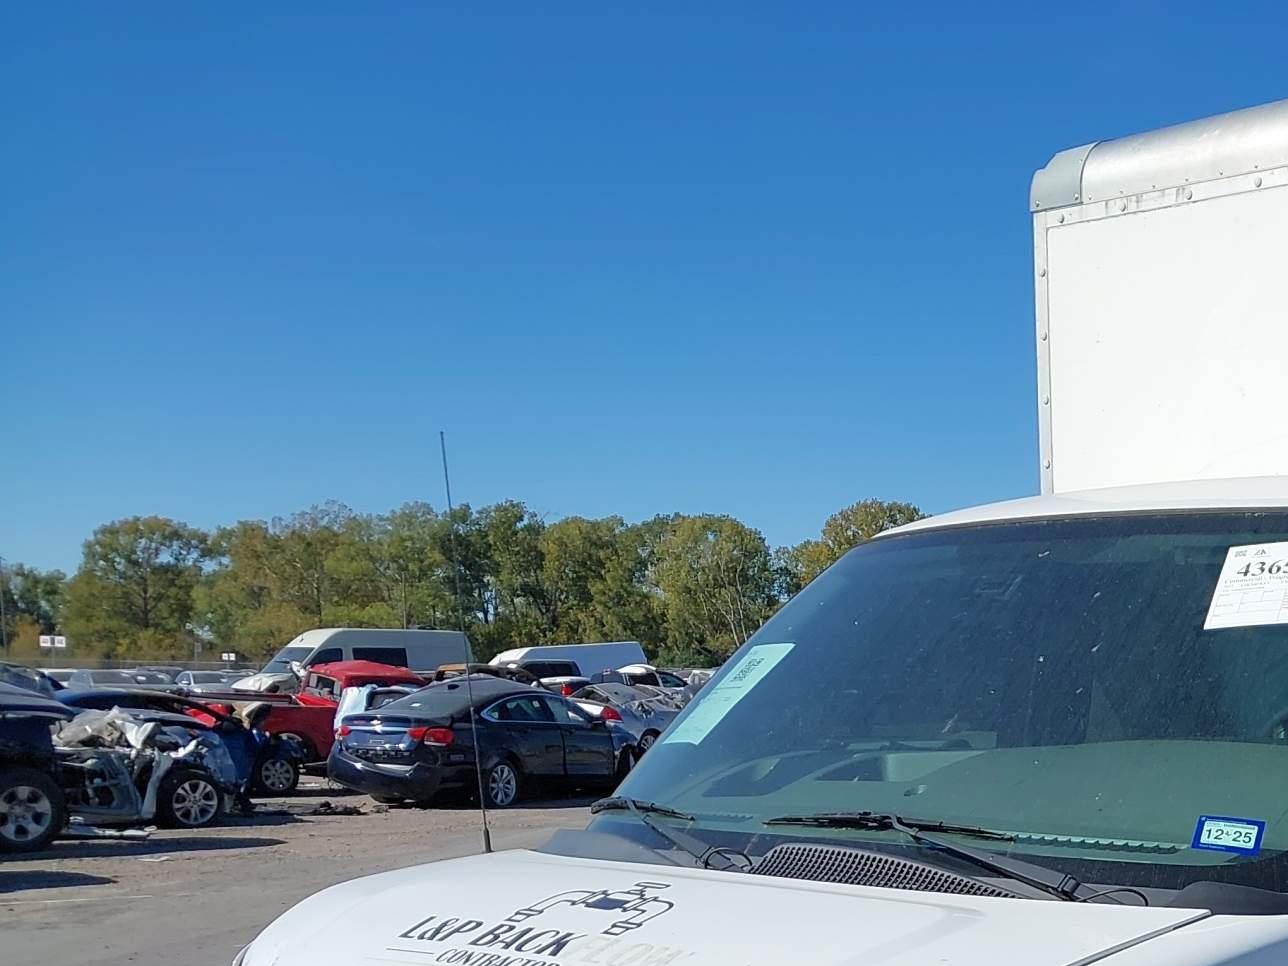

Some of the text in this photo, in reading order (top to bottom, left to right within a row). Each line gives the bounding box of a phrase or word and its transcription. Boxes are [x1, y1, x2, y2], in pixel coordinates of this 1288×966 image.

[1205, 827, 1225, 841] 12
[1231, 830, 1253, 844] 25
[397, 915, 484, 943] L&P
